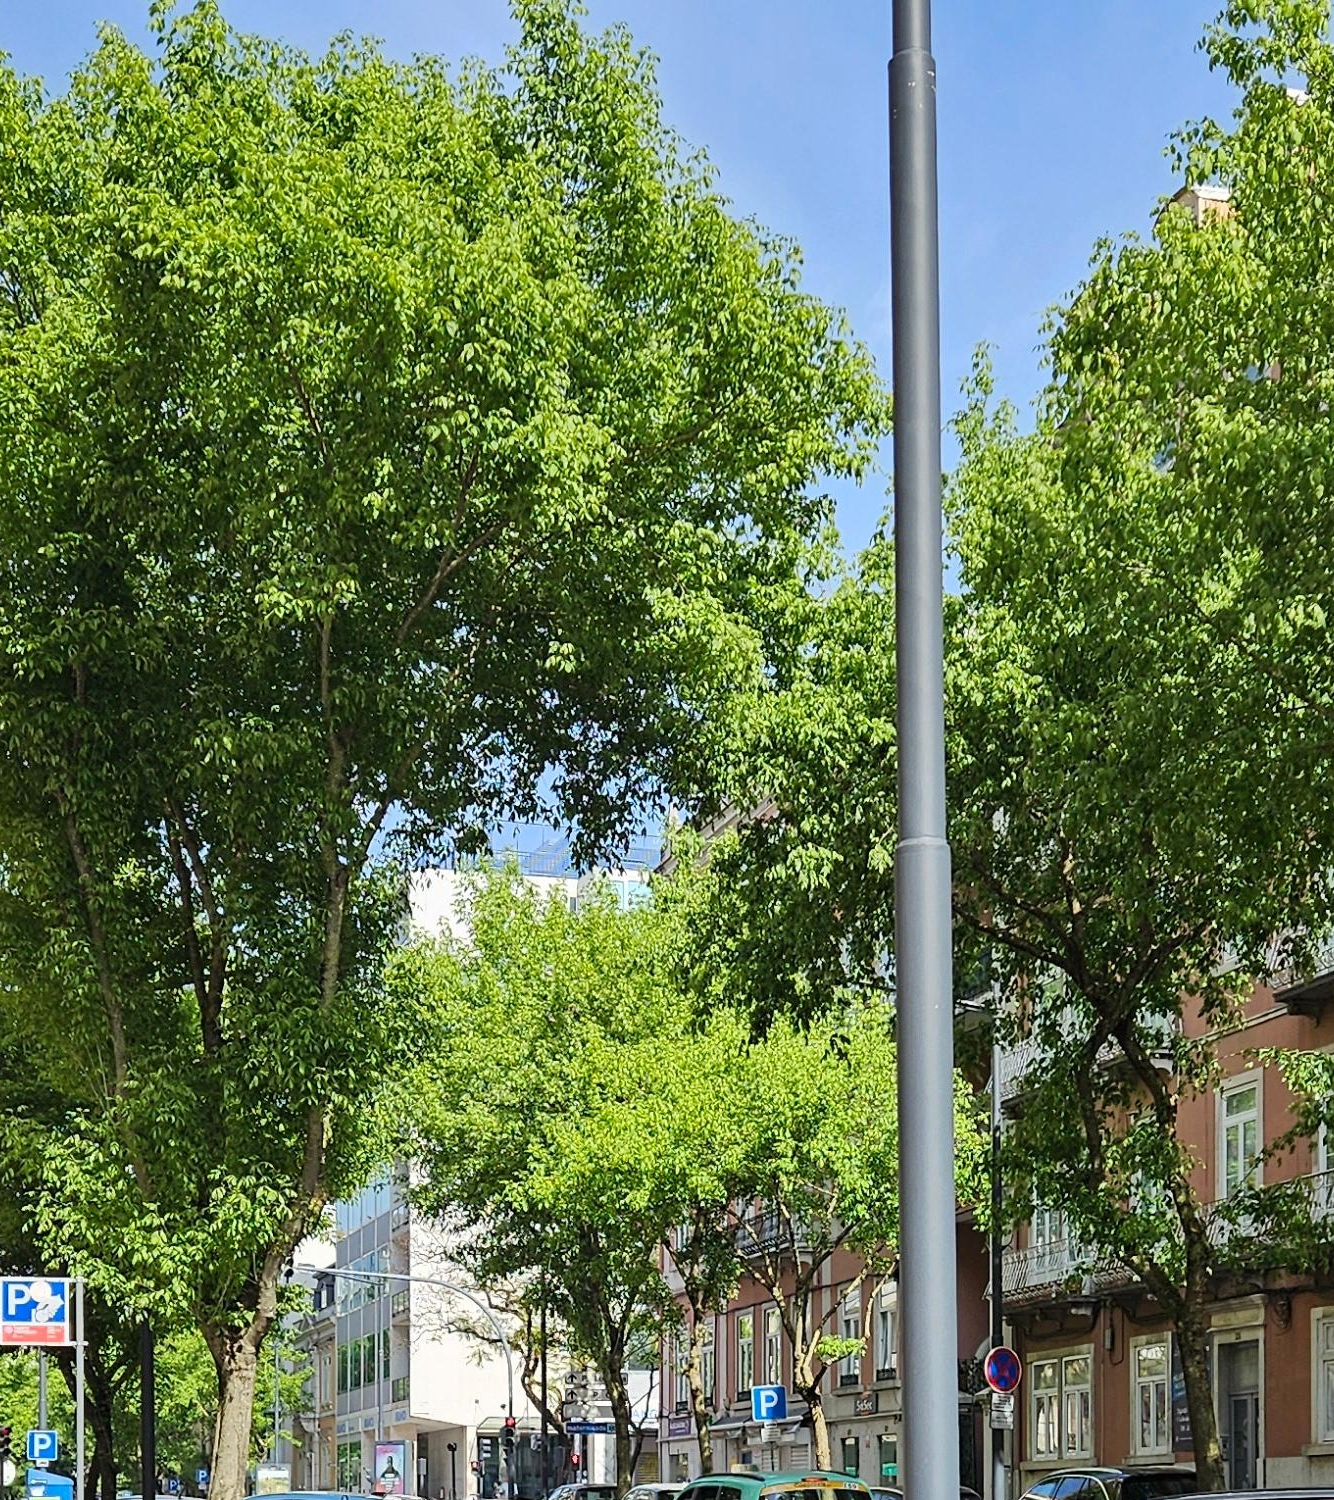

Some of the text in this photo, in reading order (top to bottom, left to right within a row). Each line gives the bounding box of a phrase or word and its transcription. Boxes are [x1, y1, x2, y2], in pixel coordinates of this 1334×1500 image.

[8, 1284, 31, 1315] P
[760, 1390, 778, 1417] P
[33, 1433, 51, 1457] P
[170, 1480, 177, 1489] P
[199, 1470, 208, 1481] P
